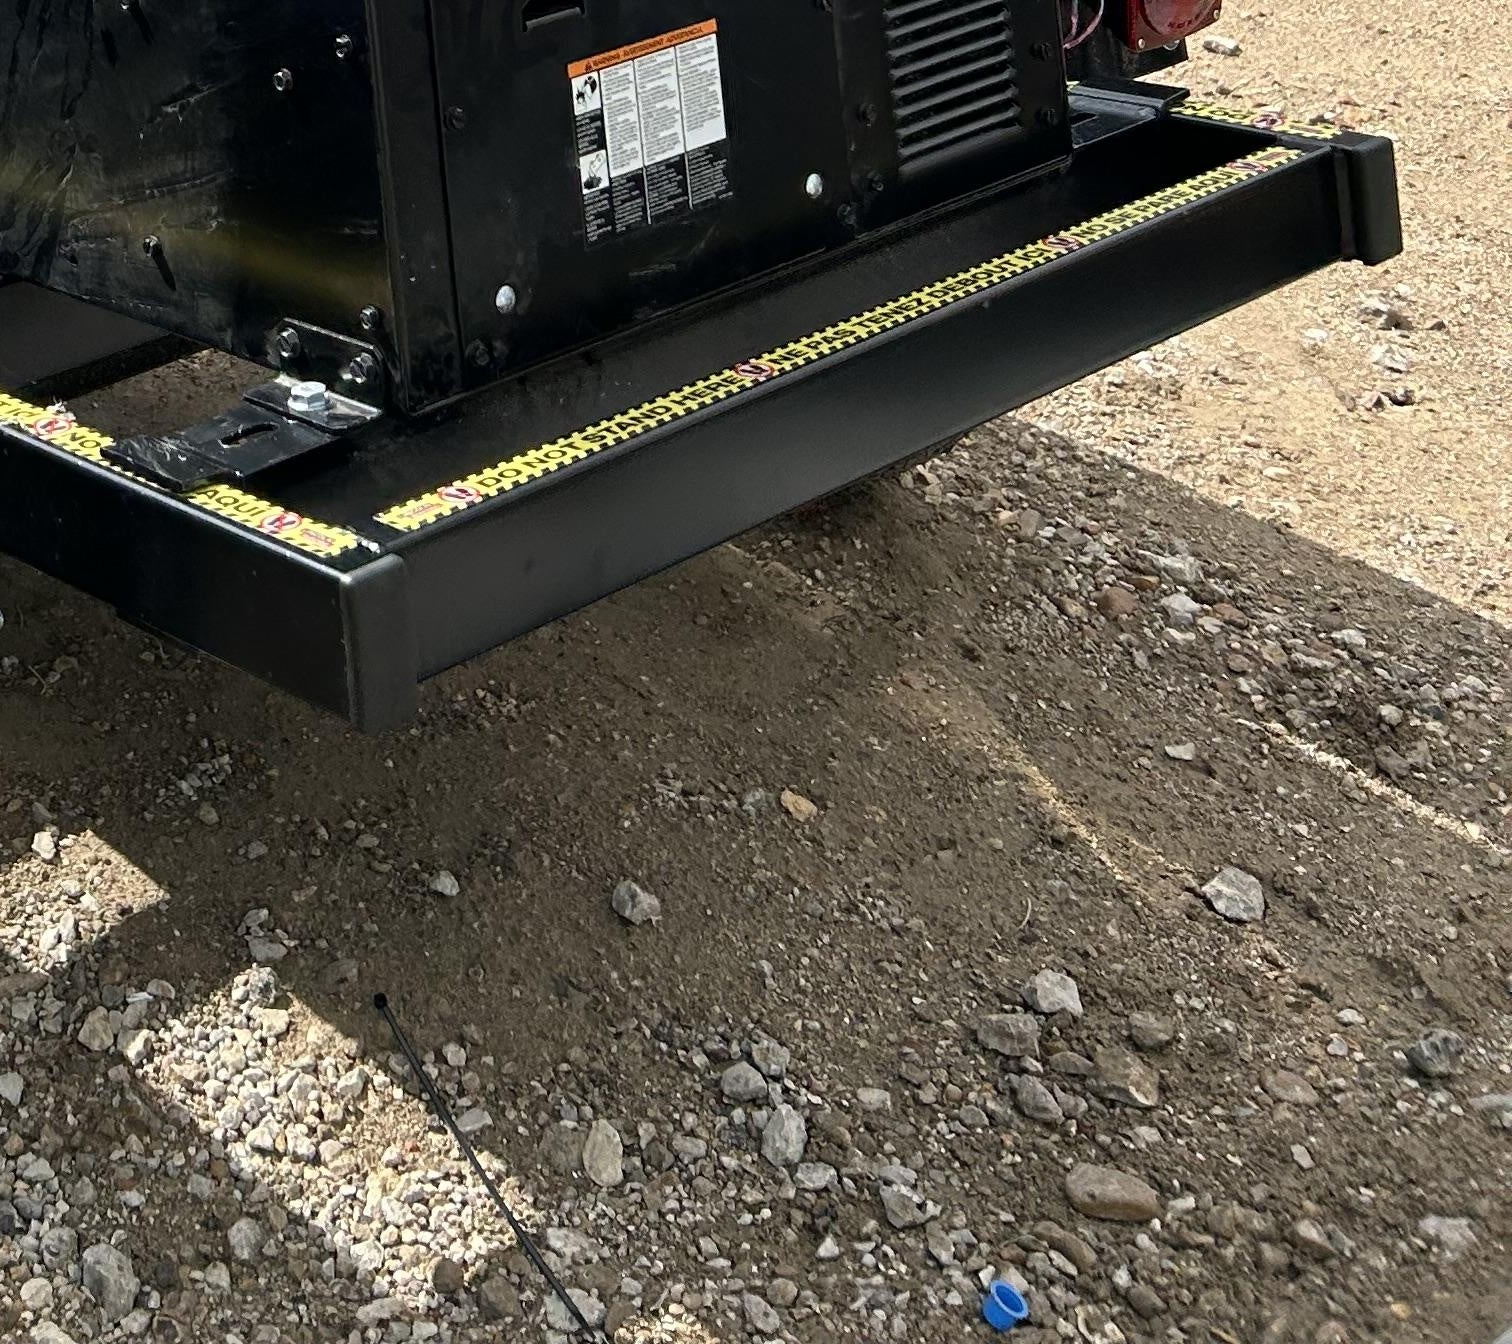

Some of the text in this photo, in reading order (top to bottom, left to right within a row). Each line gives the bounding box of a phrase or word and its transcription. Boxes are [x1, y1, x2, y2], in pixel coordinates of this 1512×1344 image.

[1072, 223, 1106, 239] NO
[1106, 211, 1136, 225] SE
[1135, 189, 1190, 212] PARE
[773, 247, 1052, 365] NE PAS TENEZ DEBOUT ICI
[7, 404, 36, 419] ICI
[477, 376, 740, 490] DO NOT STAND HERE
[67, 431, 101, 449] NO
